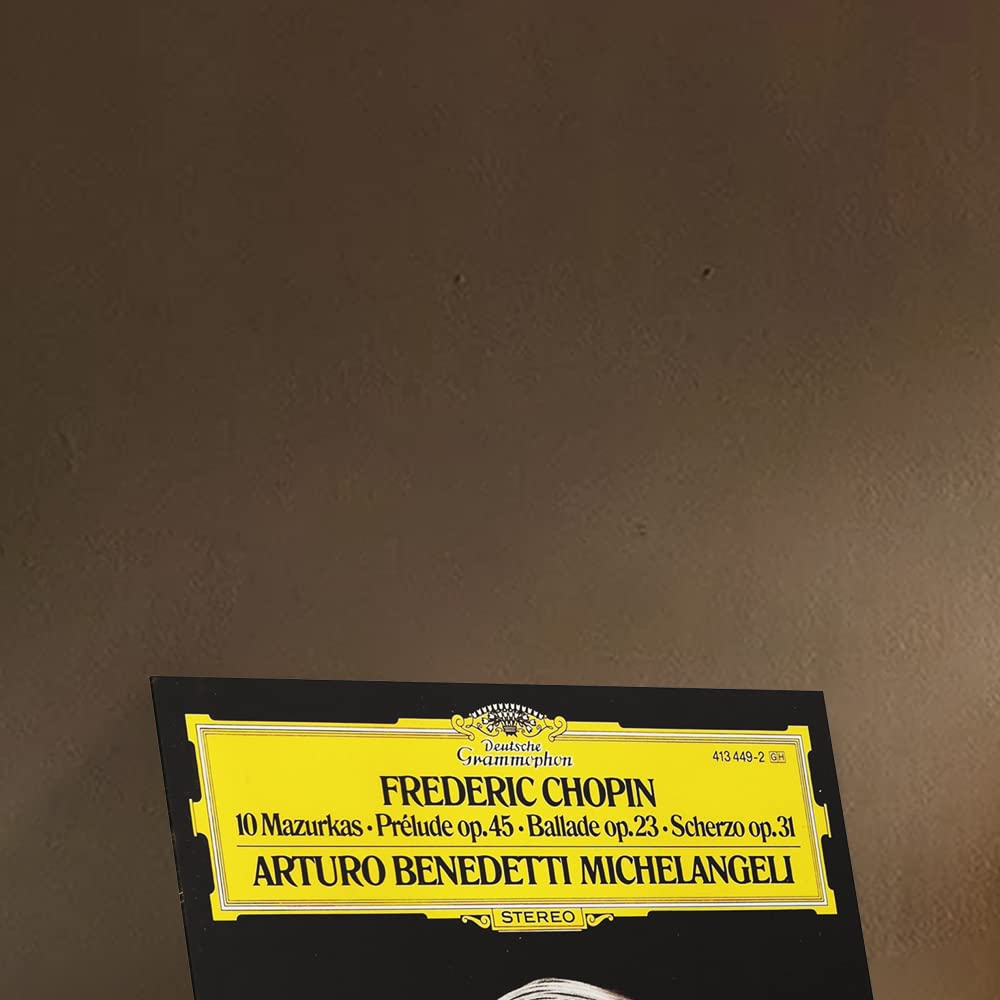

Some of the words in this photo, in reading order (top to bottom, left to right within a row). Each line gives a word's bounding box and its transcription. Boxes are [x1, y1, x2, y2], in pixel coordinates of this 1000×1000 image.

[481, 739, 541, 752] Deutsche
[713, 750, 731, 762] 413
[733, 750, 765, 763] 449-2
[457, 746, 573, 768] Grammophon
[380, 775, 537, 808] FREDERIC
[541, 776, 657, 808] CHOPIN
[236, 812, 258, 837] 10
[261, 812, 364, 837] Mazurkas
[376, 813, 453, 838] Prélude
[457, 814, 514, 843] op.45
[527, 814, 600, 838] Ballade
[604, 815, 660, 843] op.23
[671, 814, 745, 838] Scherzo
[749, 816, 796, 843] op.31
[253, 855, 386, 888] ARTURO
[392, 855, 569, 887] BENEDETTI
[580, 855, 796, 885] MICHELANGELI
[501, 910, 575, 924] STEREO
